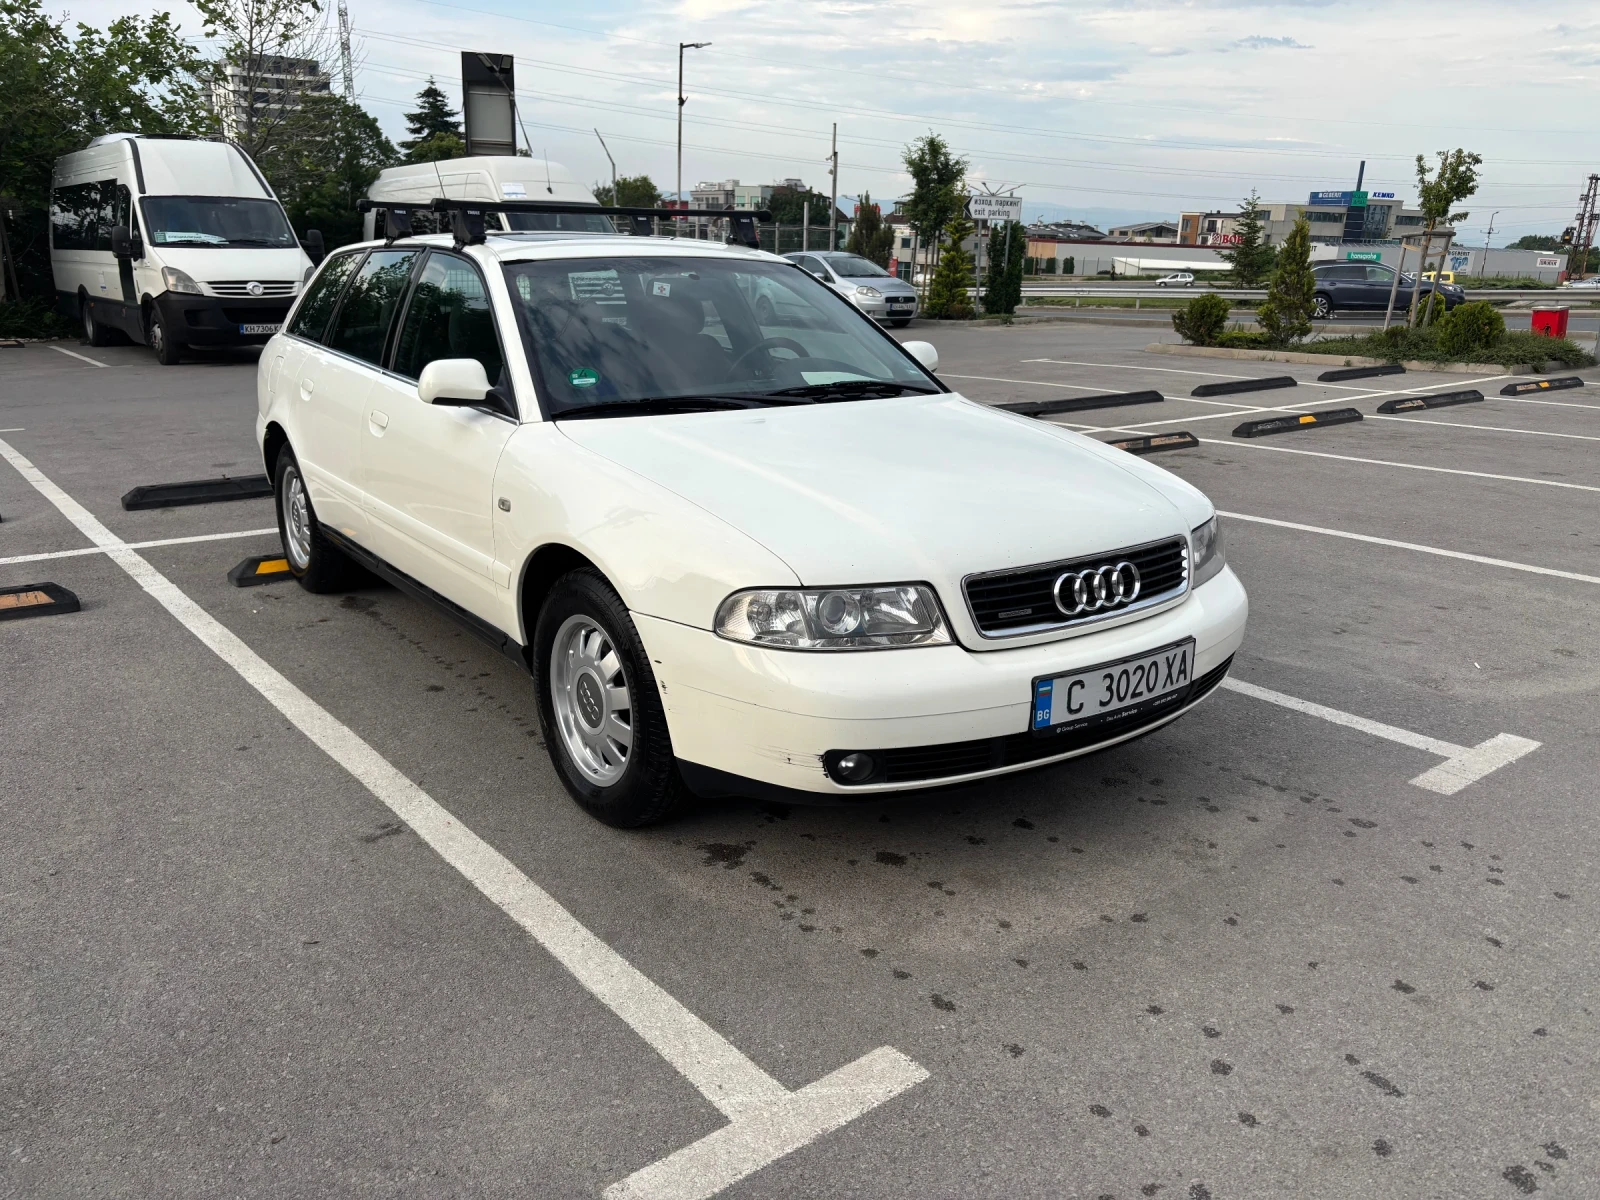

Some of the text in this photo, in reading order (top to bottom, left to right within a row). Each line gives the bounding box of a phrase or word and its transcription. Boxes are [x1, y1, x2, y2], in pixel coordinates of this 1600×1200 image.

[974, 198, 1020, 208] изход паркинг
[974, 208, 1010, 219] exit parking
[1066, 679, 1085, 715] C
[1099, 660, 1159, 707] 3020
[1037, 709, 1050, 722] BG
[1122, 708, 1138, 717] Service
